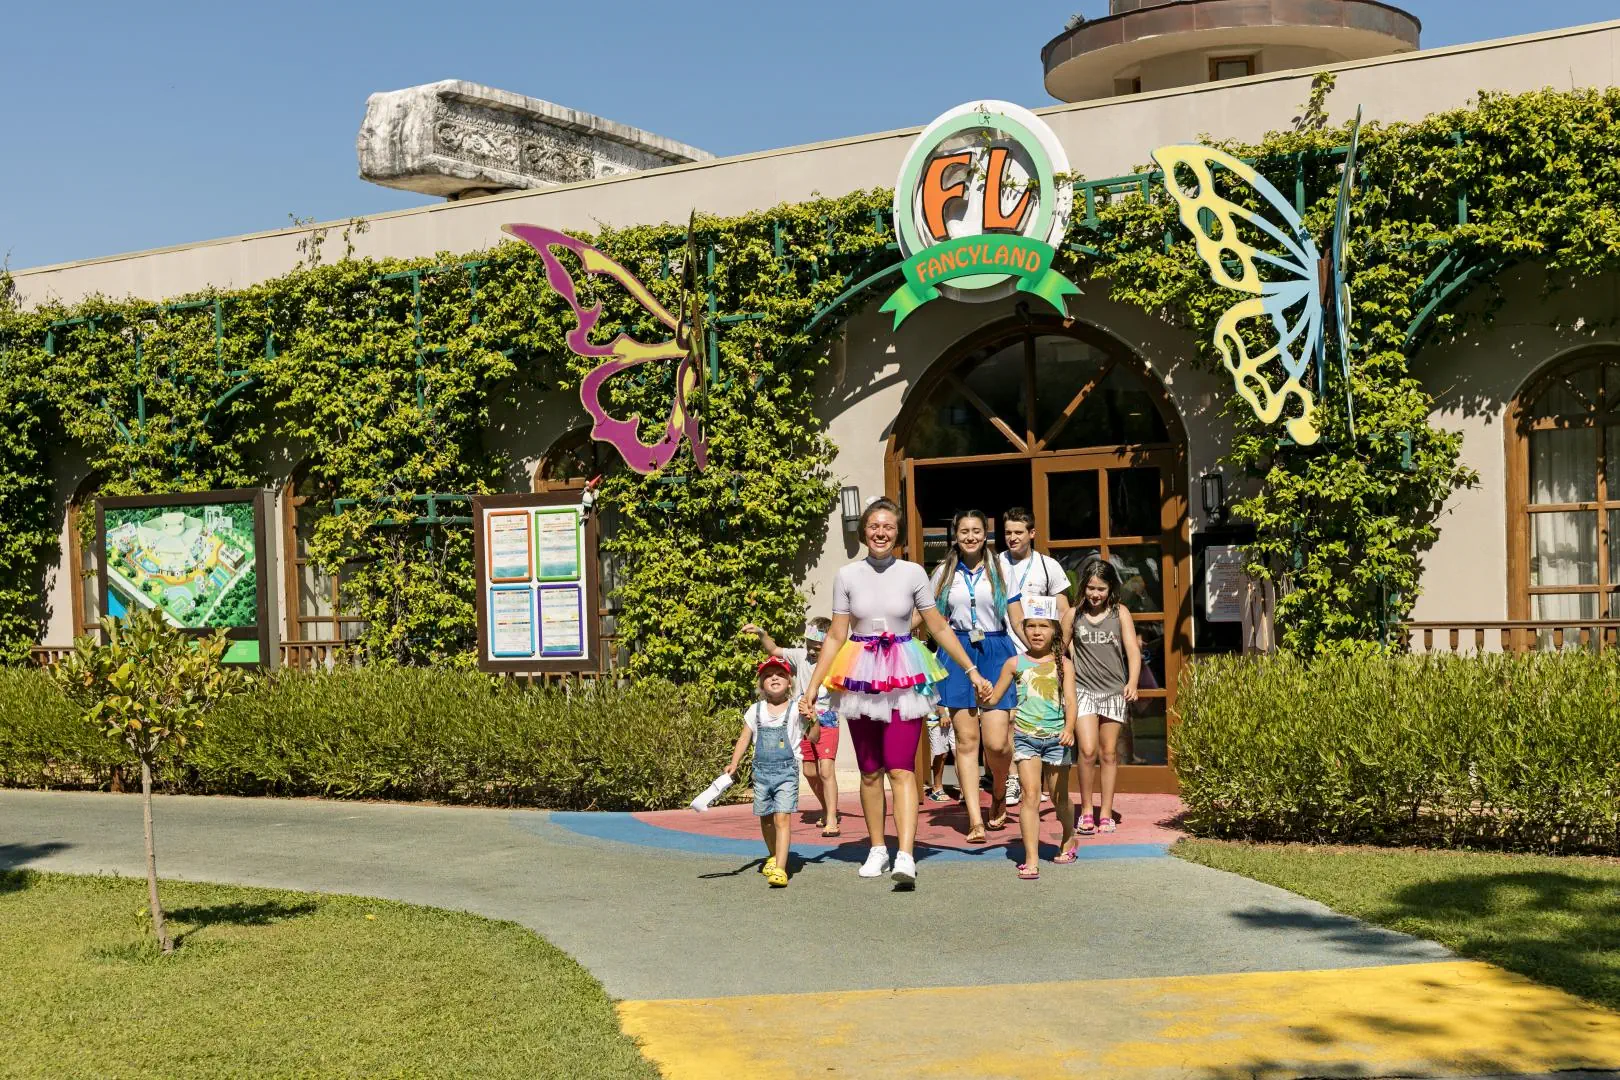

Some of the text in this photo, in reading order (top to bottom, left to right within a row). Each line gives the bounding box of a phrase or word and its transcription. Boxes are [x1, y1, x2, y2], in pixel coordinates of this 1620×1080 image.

[922, 147, 1032, 241] FL
[916, 244, 1041, 283] FANCYLAND
[1079, 630, 1119, 646] CUBA
